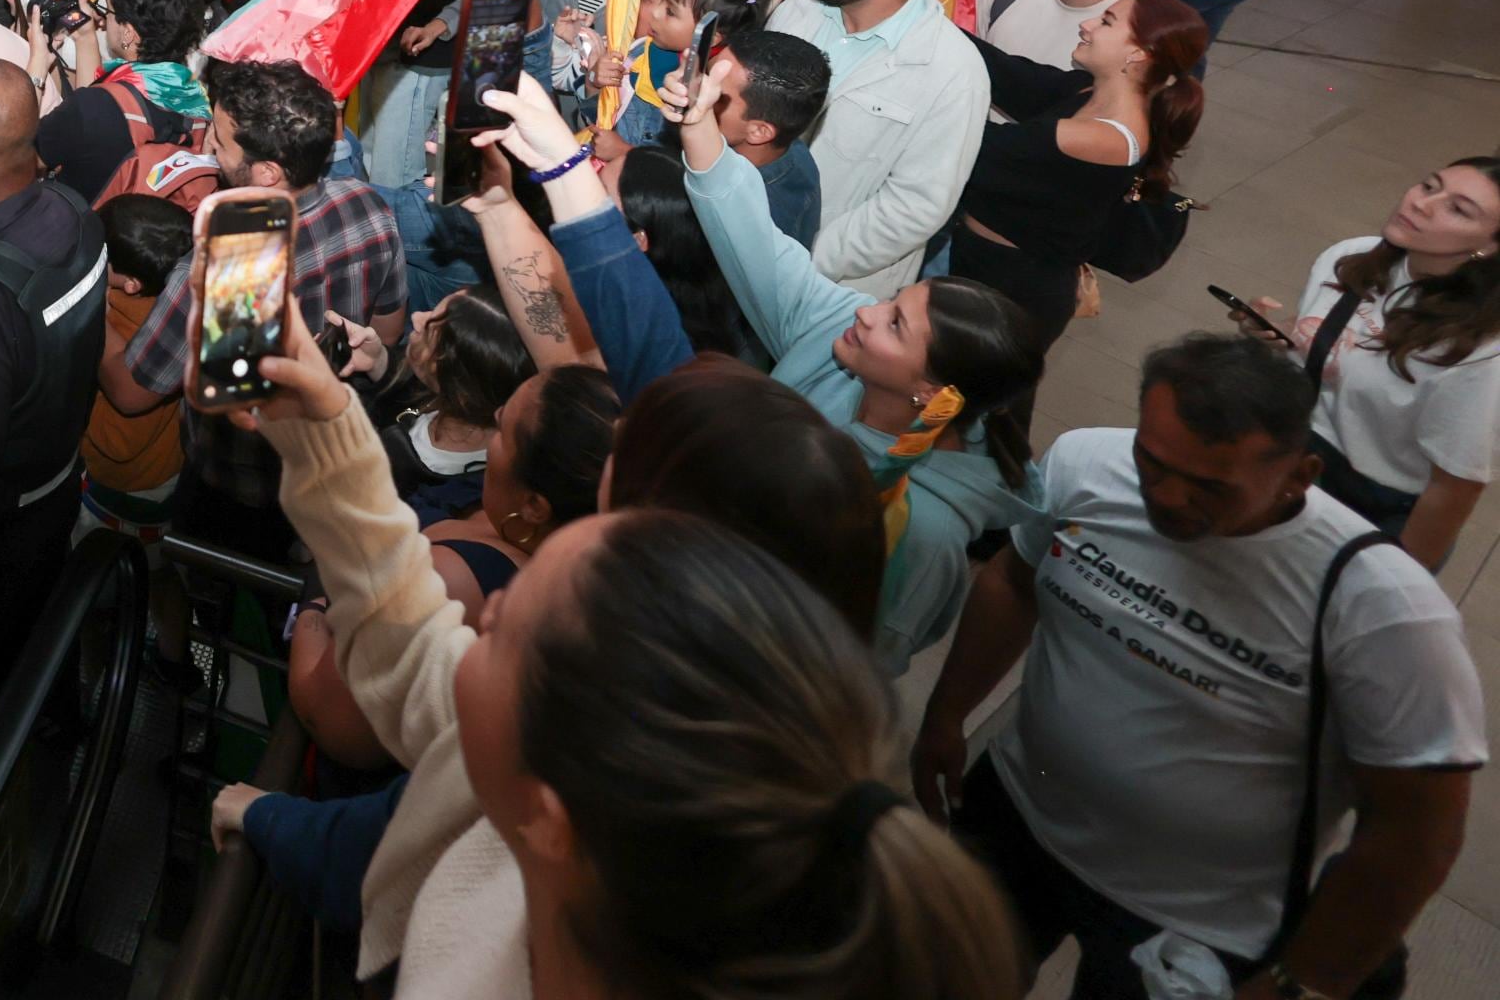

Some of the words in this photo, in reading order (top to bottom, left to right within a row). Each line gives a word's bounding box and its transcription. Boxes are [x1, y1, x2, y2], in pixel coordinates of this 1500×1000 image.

[1067, 558, 1167, 629] PRESIDENTA
[1077, 541, 1179, 620] Claudia
[1181, 607, 1303, 688] Dobles
[1106, 626, 1122, 643] A
[1126, 638, 1221, 696] GANAR!
